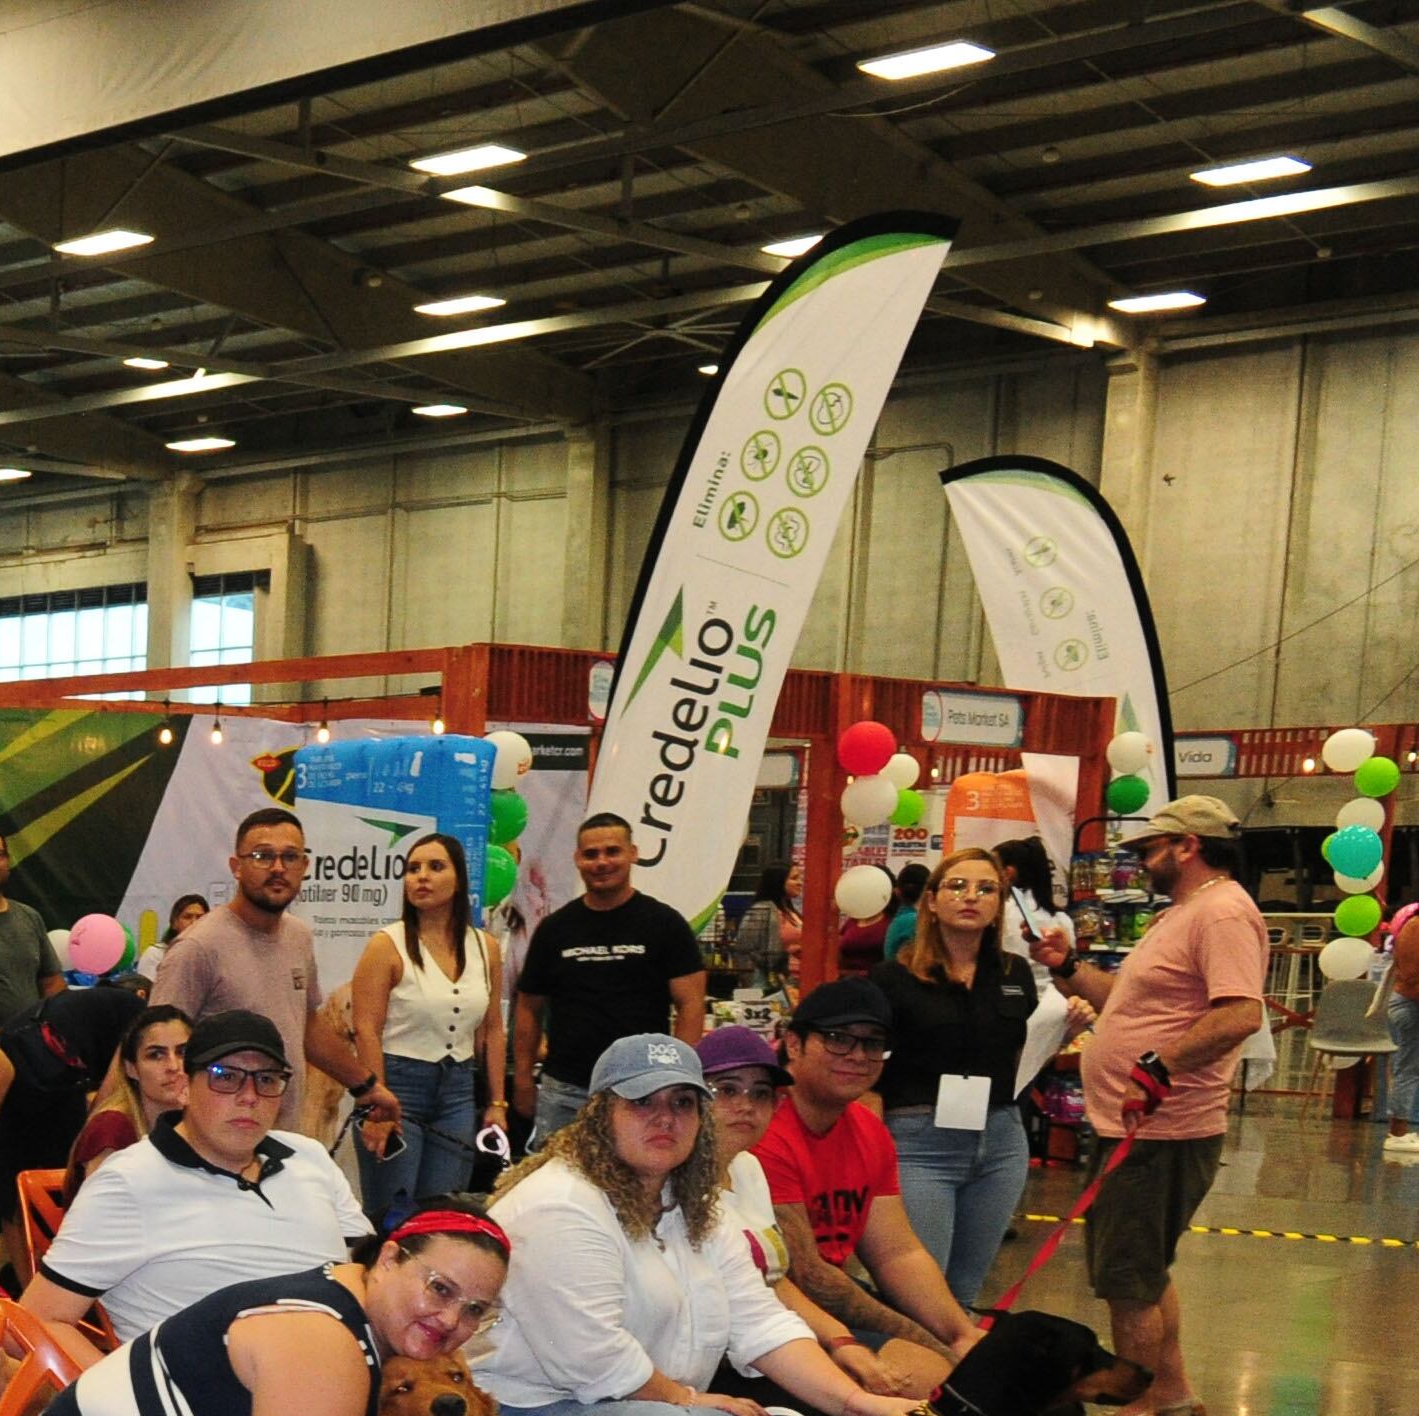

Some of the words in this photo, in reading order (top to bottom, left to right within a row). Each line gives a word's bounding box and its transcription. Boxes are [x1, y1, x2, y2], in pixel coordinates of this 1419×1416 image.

[692, 451, 731, 529] Elimina:
[704, 604, 777, 759] PLUS
[297, 763, 308, 789] 3
[966, 791, 980, 811] 3
[894, 828, 928, 841] 200
[648, 1043, 677, 1055] DOG
